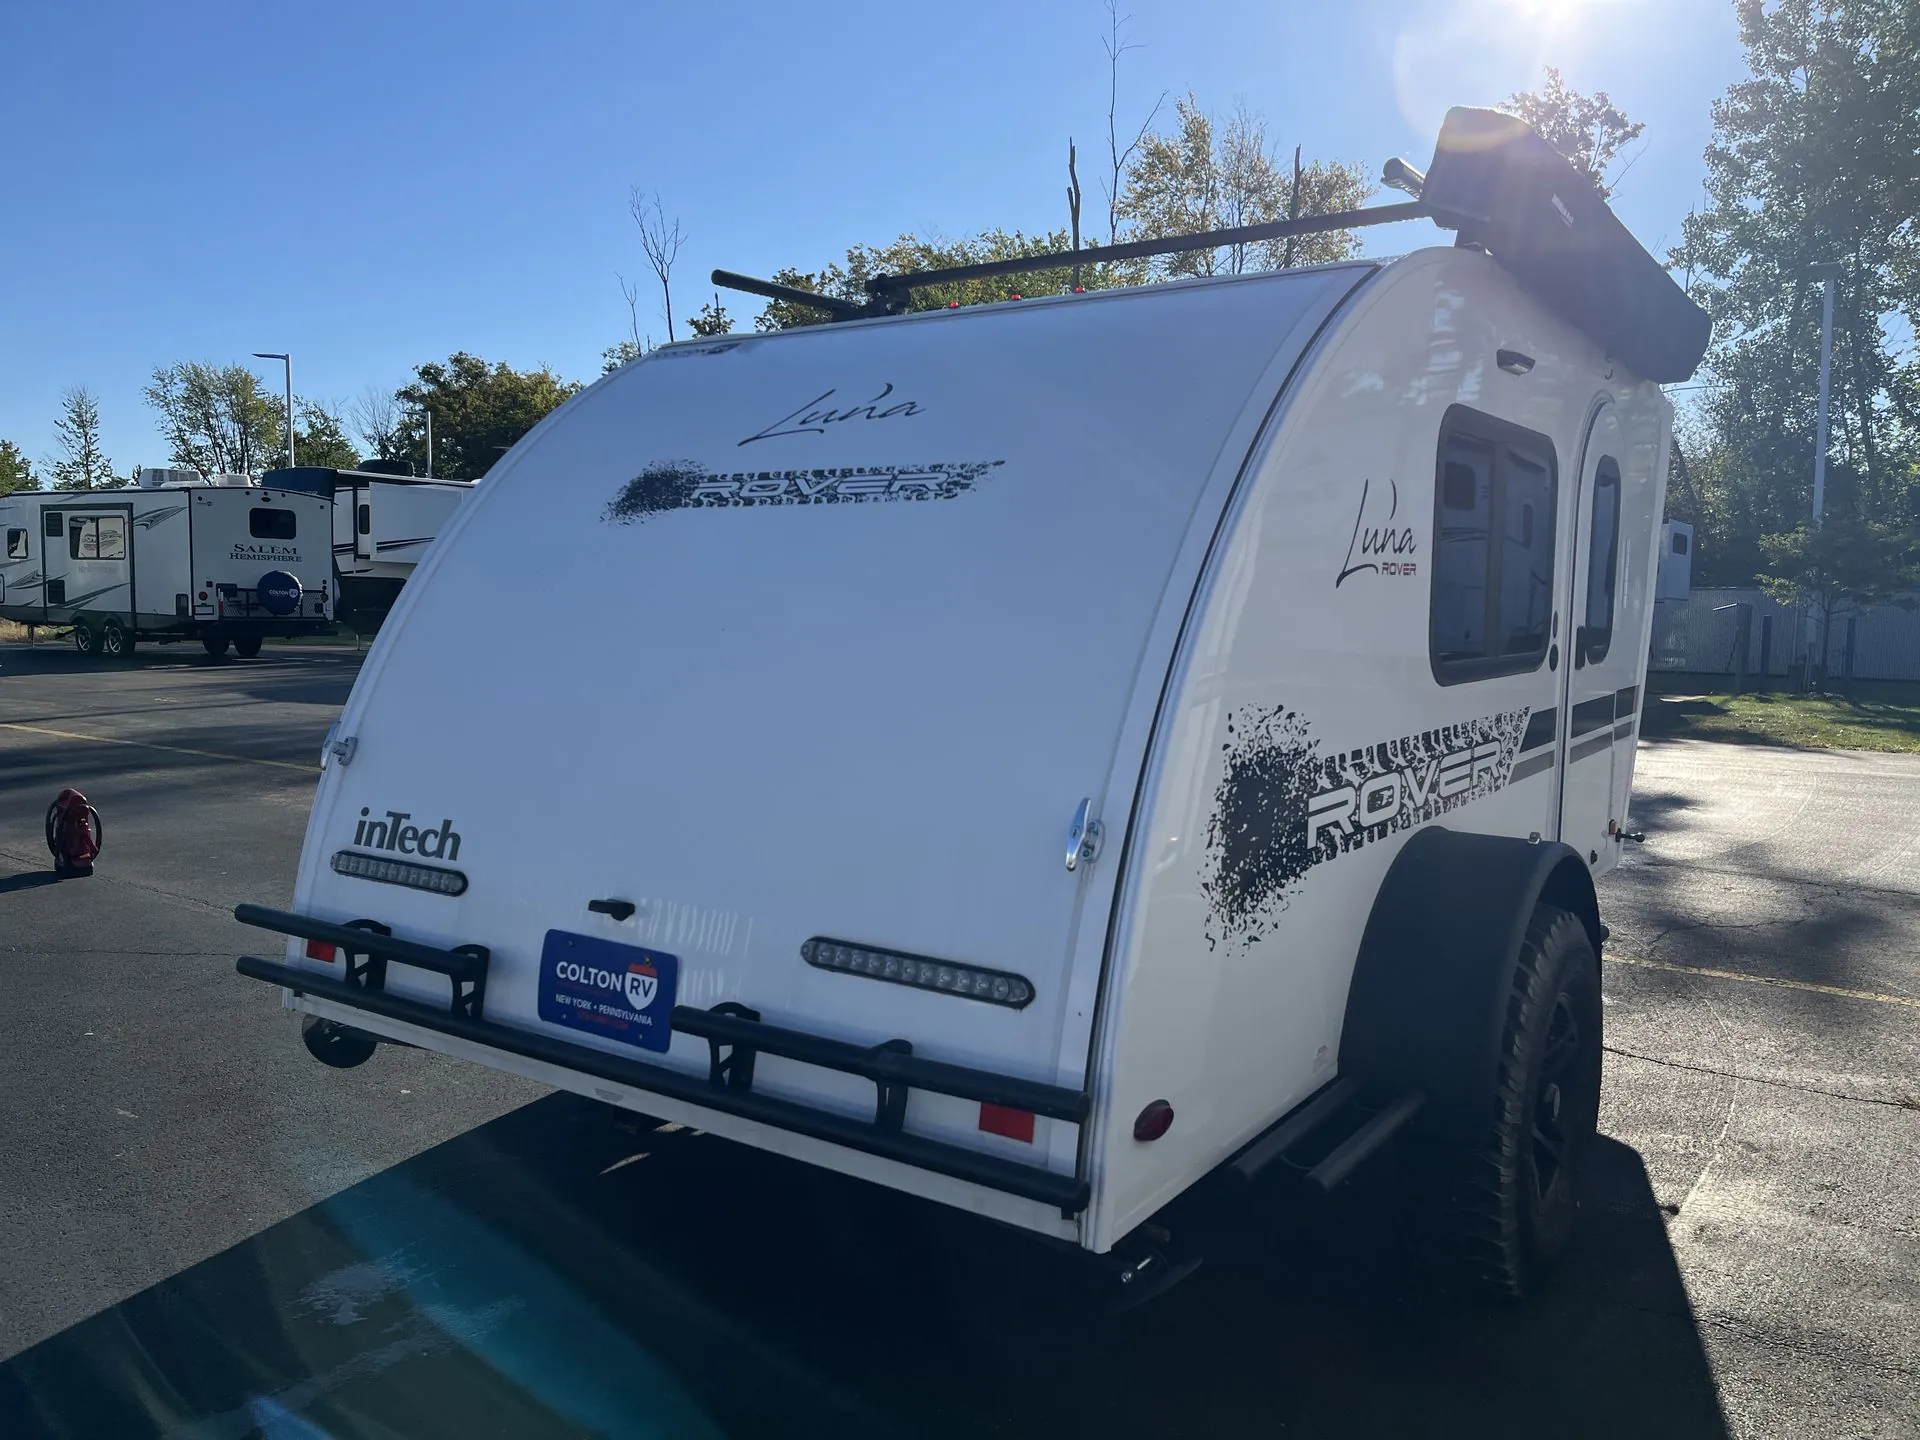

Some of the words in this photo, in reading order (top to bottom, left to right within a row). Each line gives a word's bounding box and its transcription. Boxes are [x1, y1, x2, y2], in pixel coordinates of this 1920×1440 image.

[737, 382, 927, 447] Luna
[690, 472, 950, 499] ROVER
[233, 543, 297, 555] SALEM
[1336, 479, 1417, 589] Luna
[229, 552, 303, 563] HEMISPHERE
[1382, 562, 1417, 576] ROVER
[1306, 740, 1503, 850] ROVER
[353, 806, 462, 861] inTech
[556, 961, 623, 992] COLTON
[629, 976, 654, 999] RV
[555, 993, 572, 1005] NEW
[572, 997, 593, 1010] YORK
[598, 1003, 653, 1026] PENNSYLVANIA
